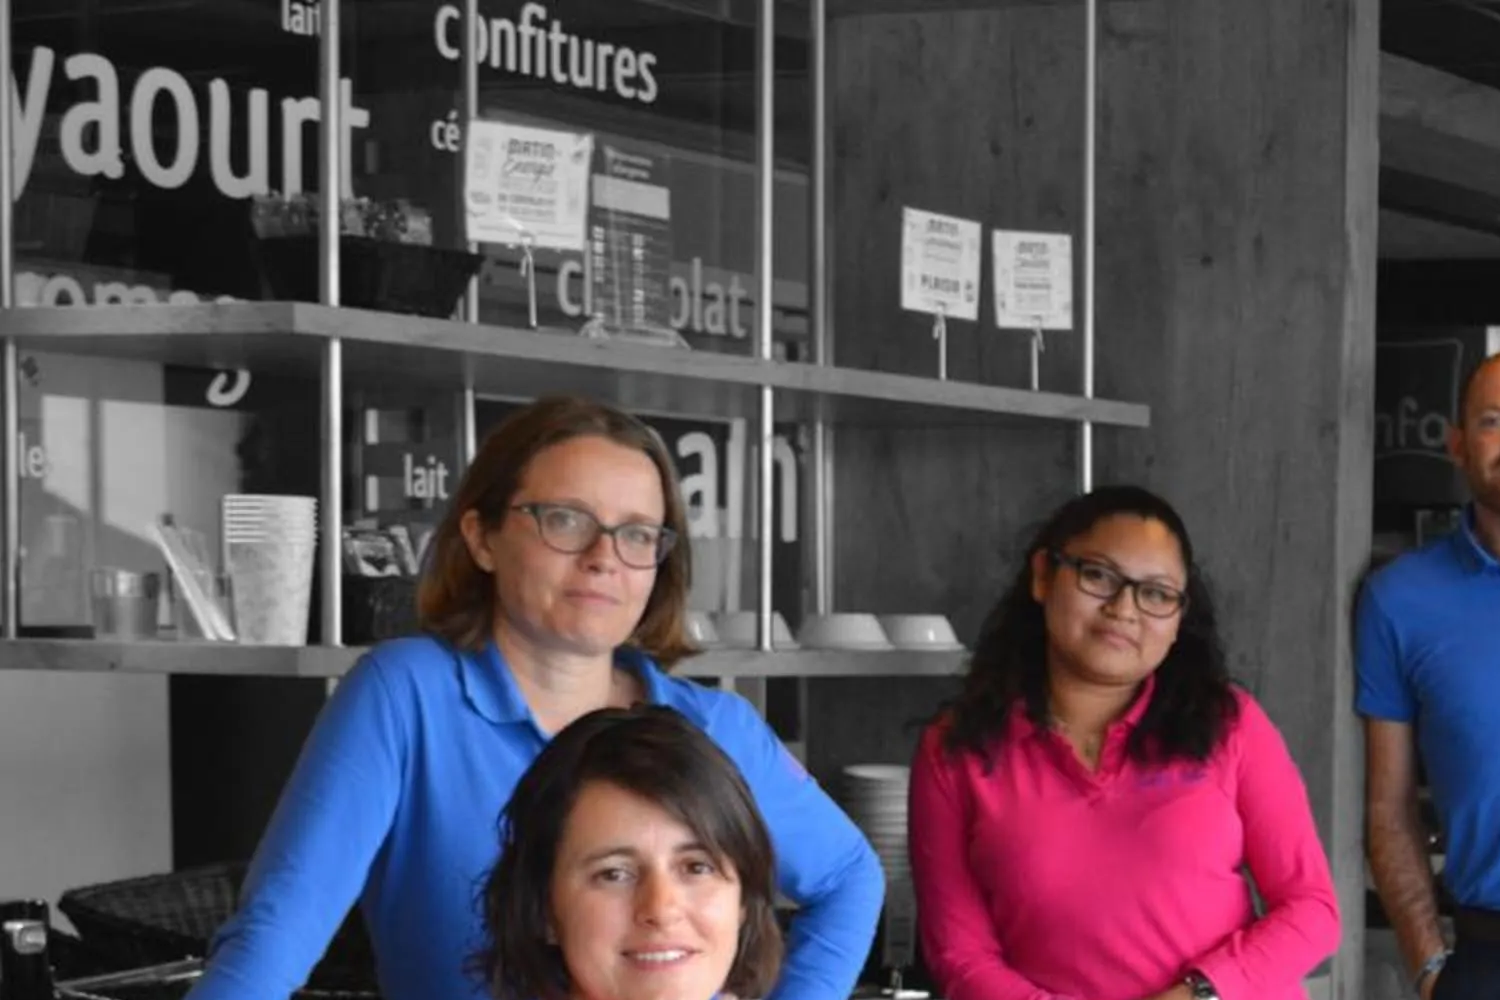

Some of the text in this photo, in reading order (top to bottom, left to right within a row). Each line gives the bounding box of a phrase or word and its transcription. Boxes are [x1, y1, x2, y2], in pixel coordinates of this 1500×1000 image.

[282, 0, 321, 36] lai
[557, 256, 748, 339] colat
[1375, 396, 1449, 448] nfo
[677, 416, 798, 543] ain
